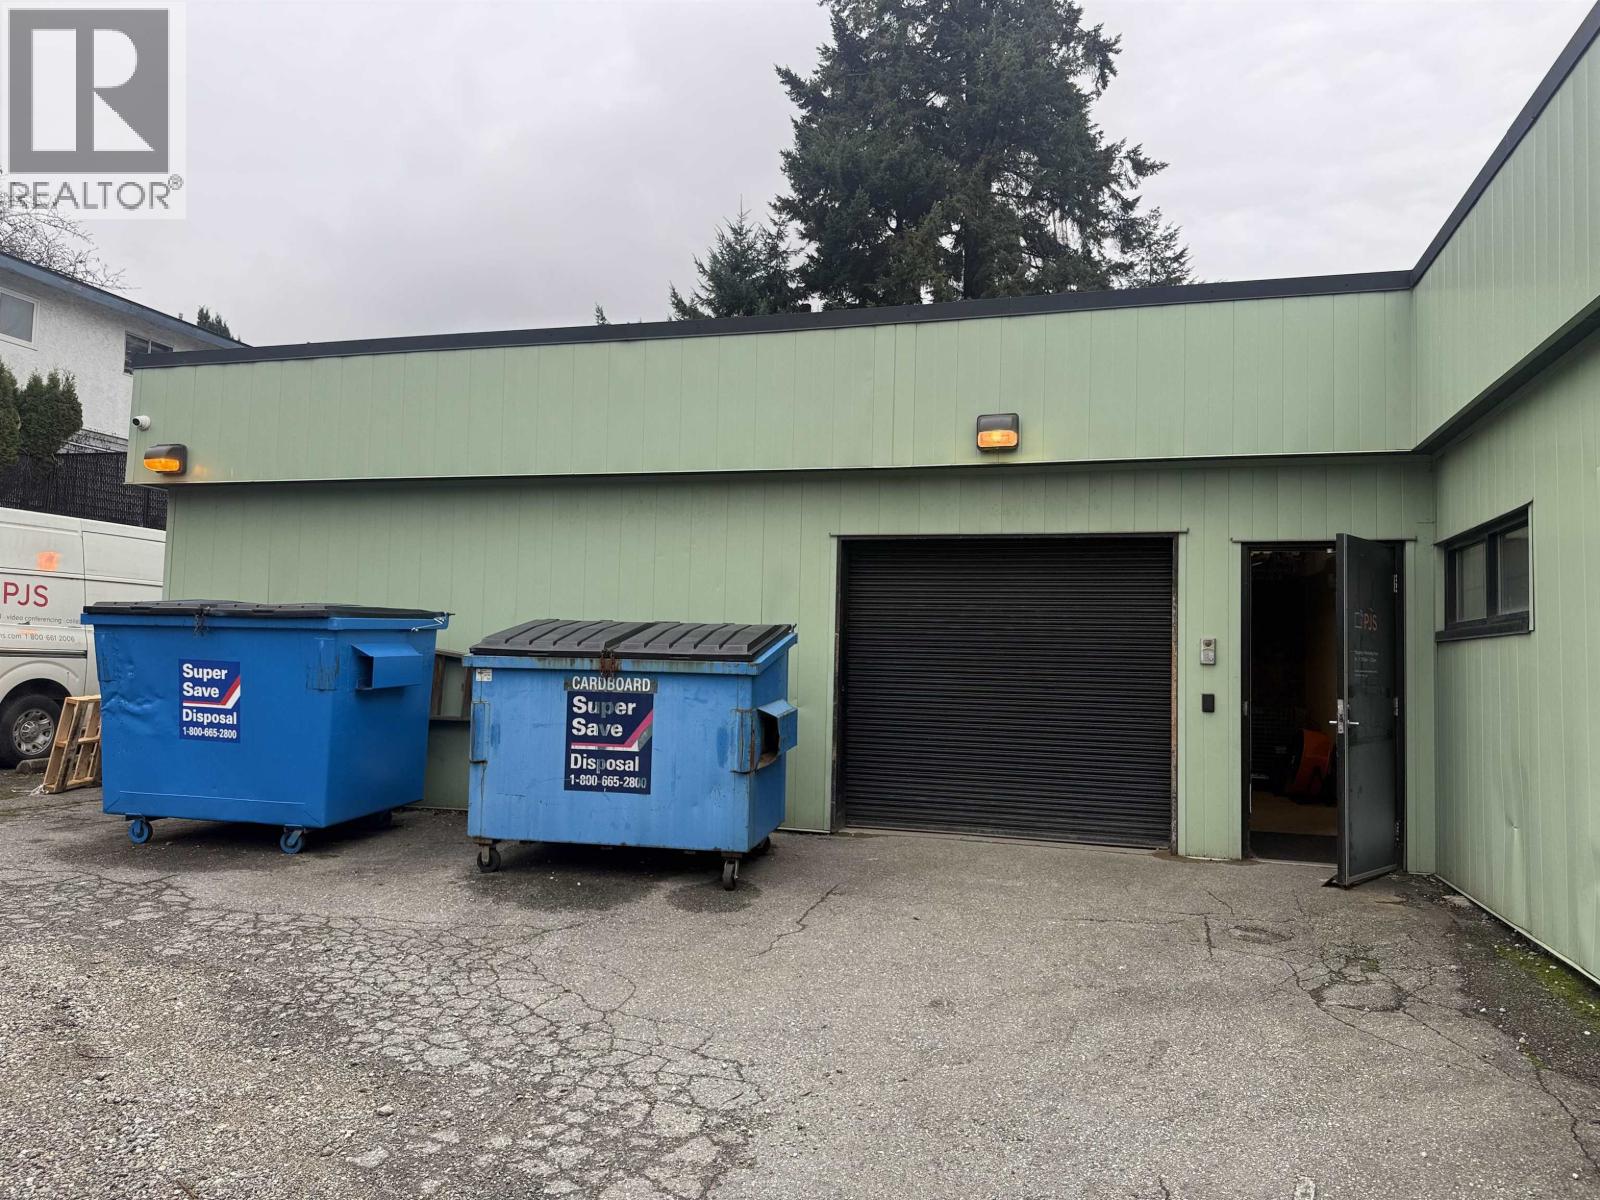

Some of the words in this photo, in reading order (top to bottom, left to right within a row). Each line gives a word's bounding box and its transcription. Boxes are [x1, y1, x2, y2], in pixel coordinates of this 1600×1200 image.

[3, 582, 49, 607] PJS
[182, 663, 228, 682] Super
[182, 681, 220, 698] Save
[572, 675, 651, 692] CARDBOARD
[572, 695, 637, 718] Super
[182, 708, 238, 726] Disposal
[182, 726, 238, 739] 1-800-665-2800
[571, 717, 623, 737] Save
[570, 753, 640, 774] Disposal
